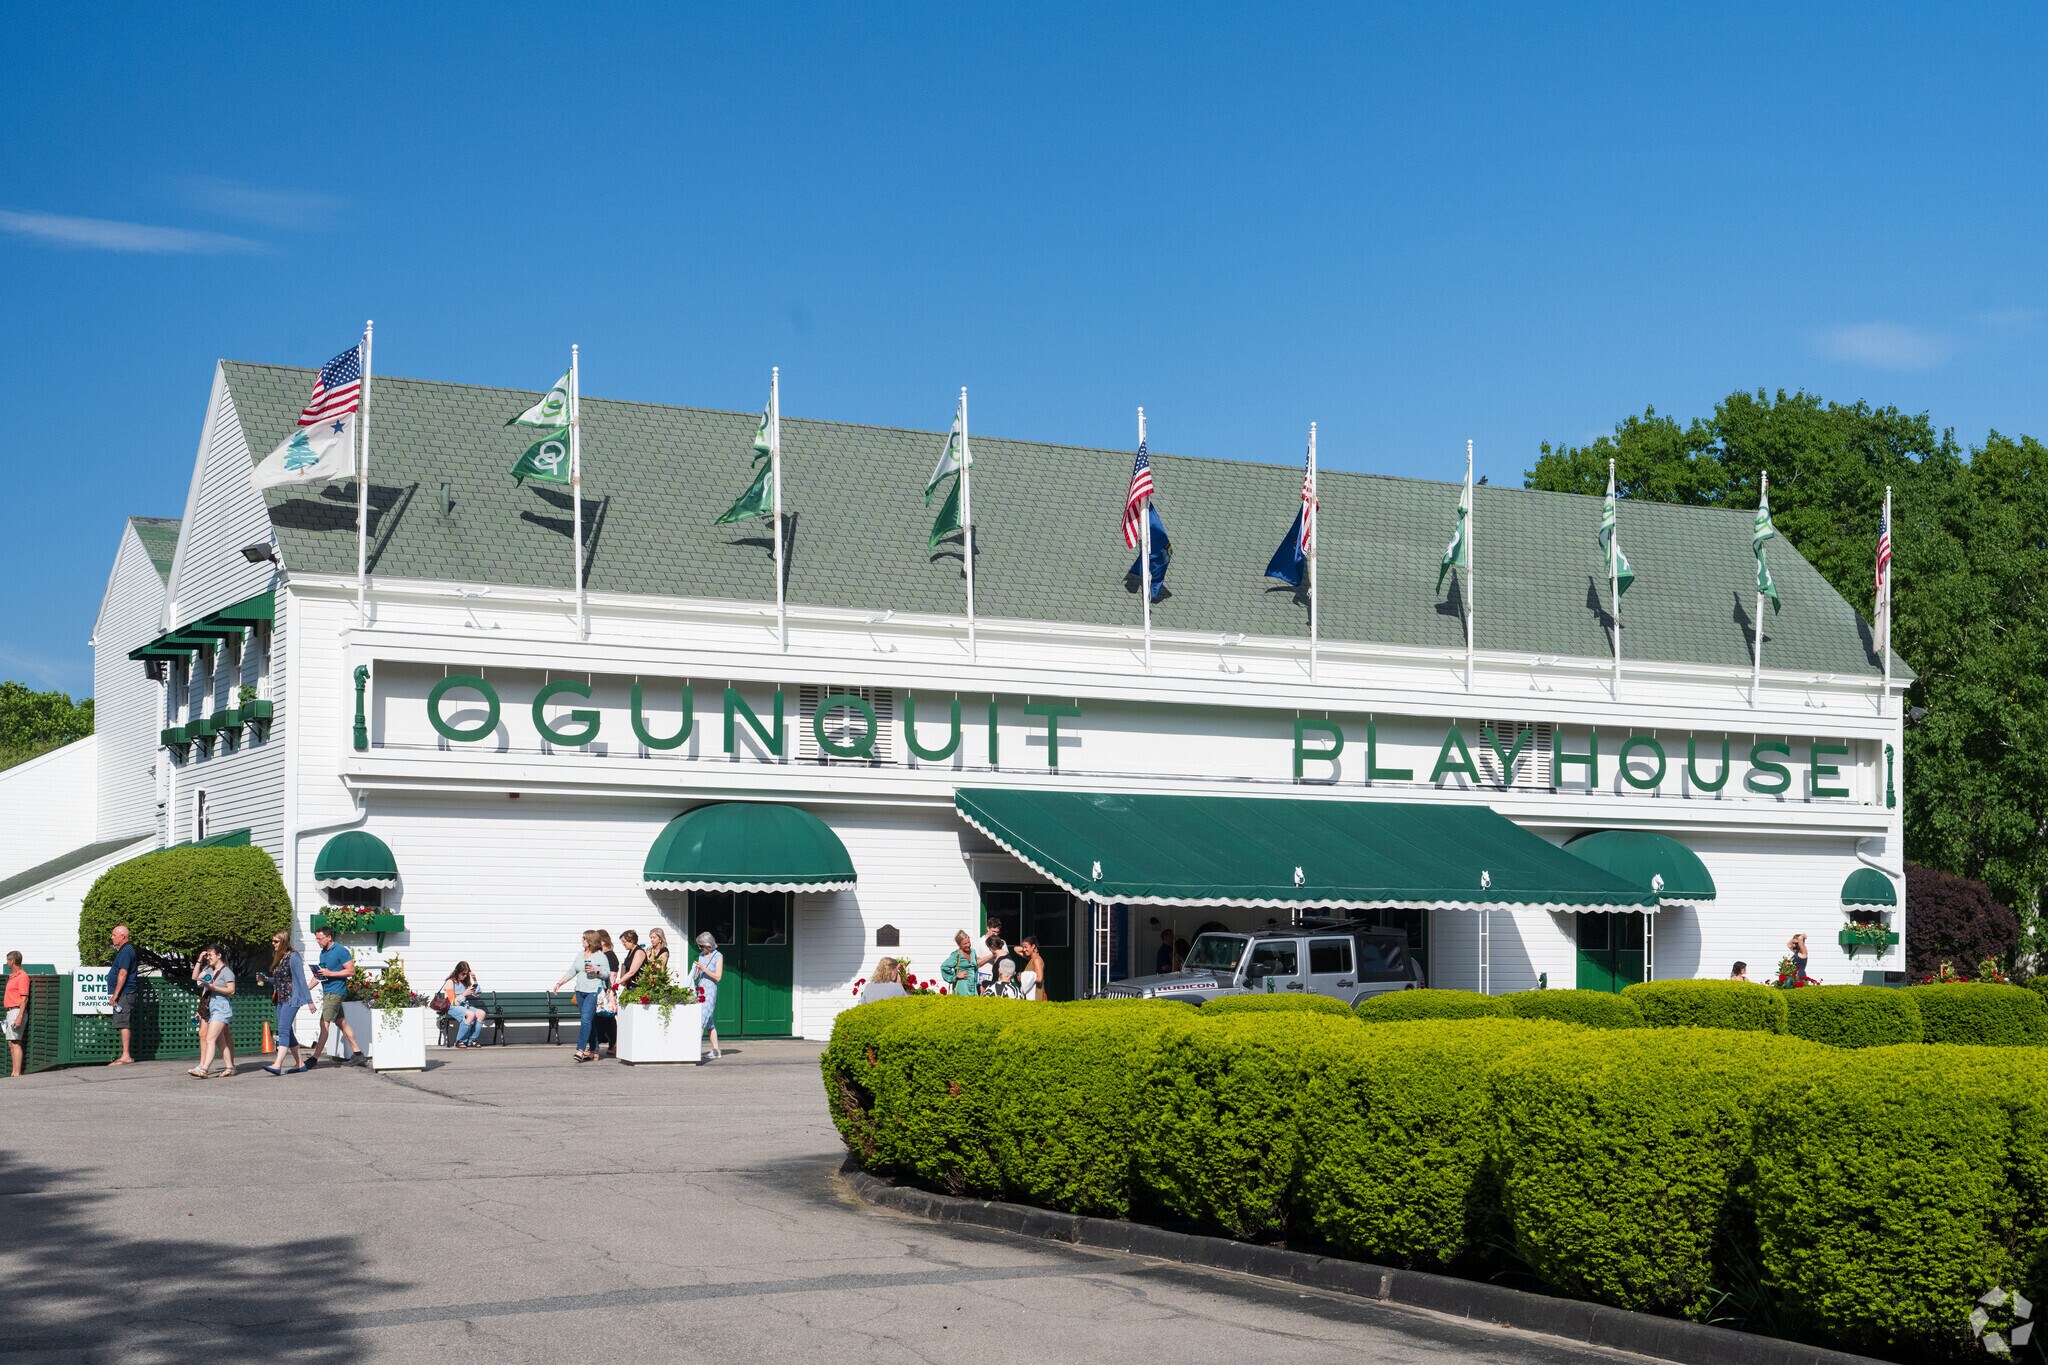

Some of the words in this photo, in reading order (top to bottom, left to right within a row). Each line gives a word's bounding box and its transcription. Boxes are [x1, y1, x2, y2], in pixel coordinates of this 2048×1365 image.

[428, 674, 1082, 766] OGUNQUIT
[1293, 717, 1849, 797] PLAYHOUSE
[78, 974, 94, 982] DO
[81, 984, 107, 992] ENTE
[1157, 983, 1216, 992] RUBICON
